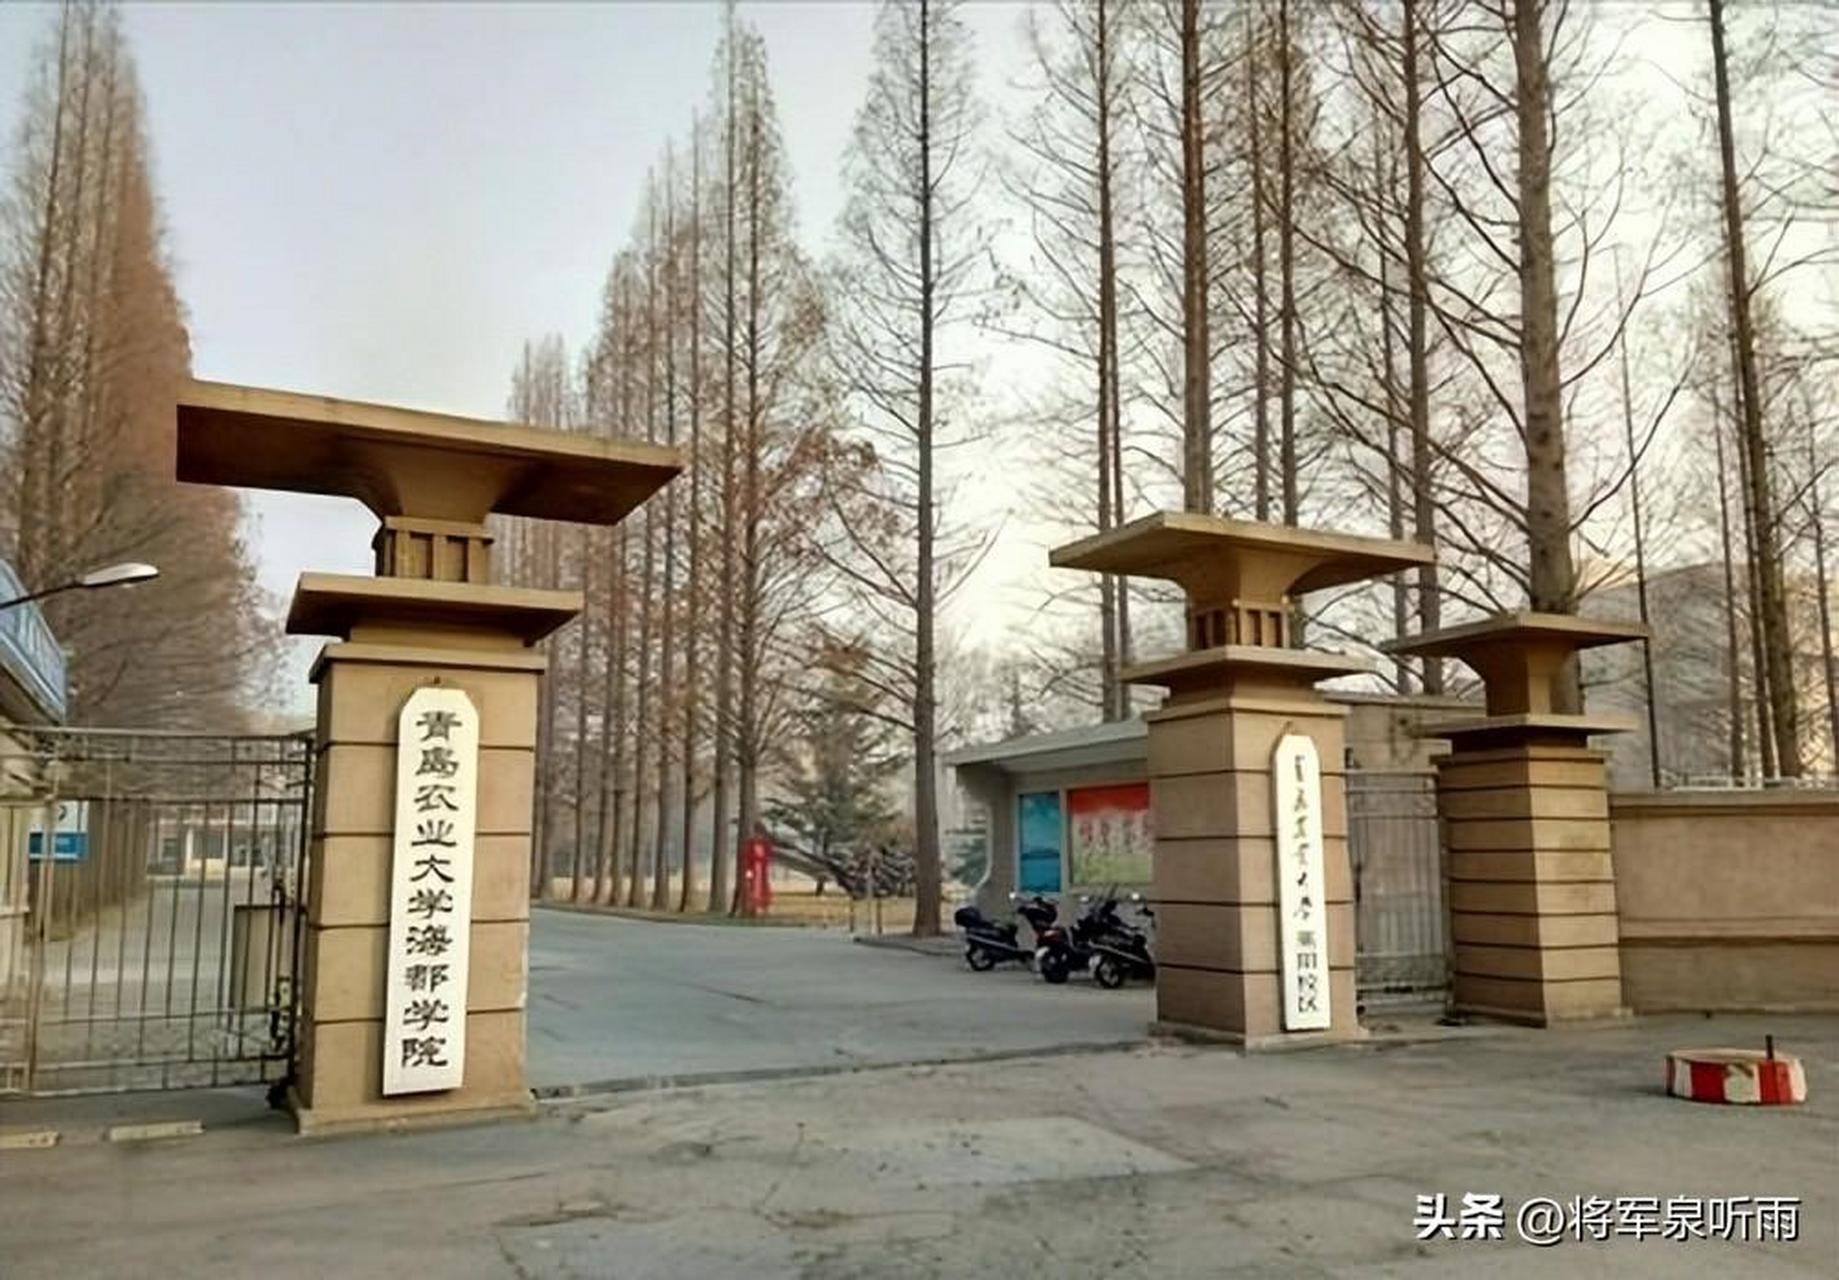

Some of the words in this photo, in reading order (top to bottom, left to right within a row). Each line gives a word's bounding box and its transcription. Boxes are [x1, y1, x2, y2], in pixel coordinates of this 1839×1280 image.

[401, 710, 462, 1068] 青岛农业大学海都学院
